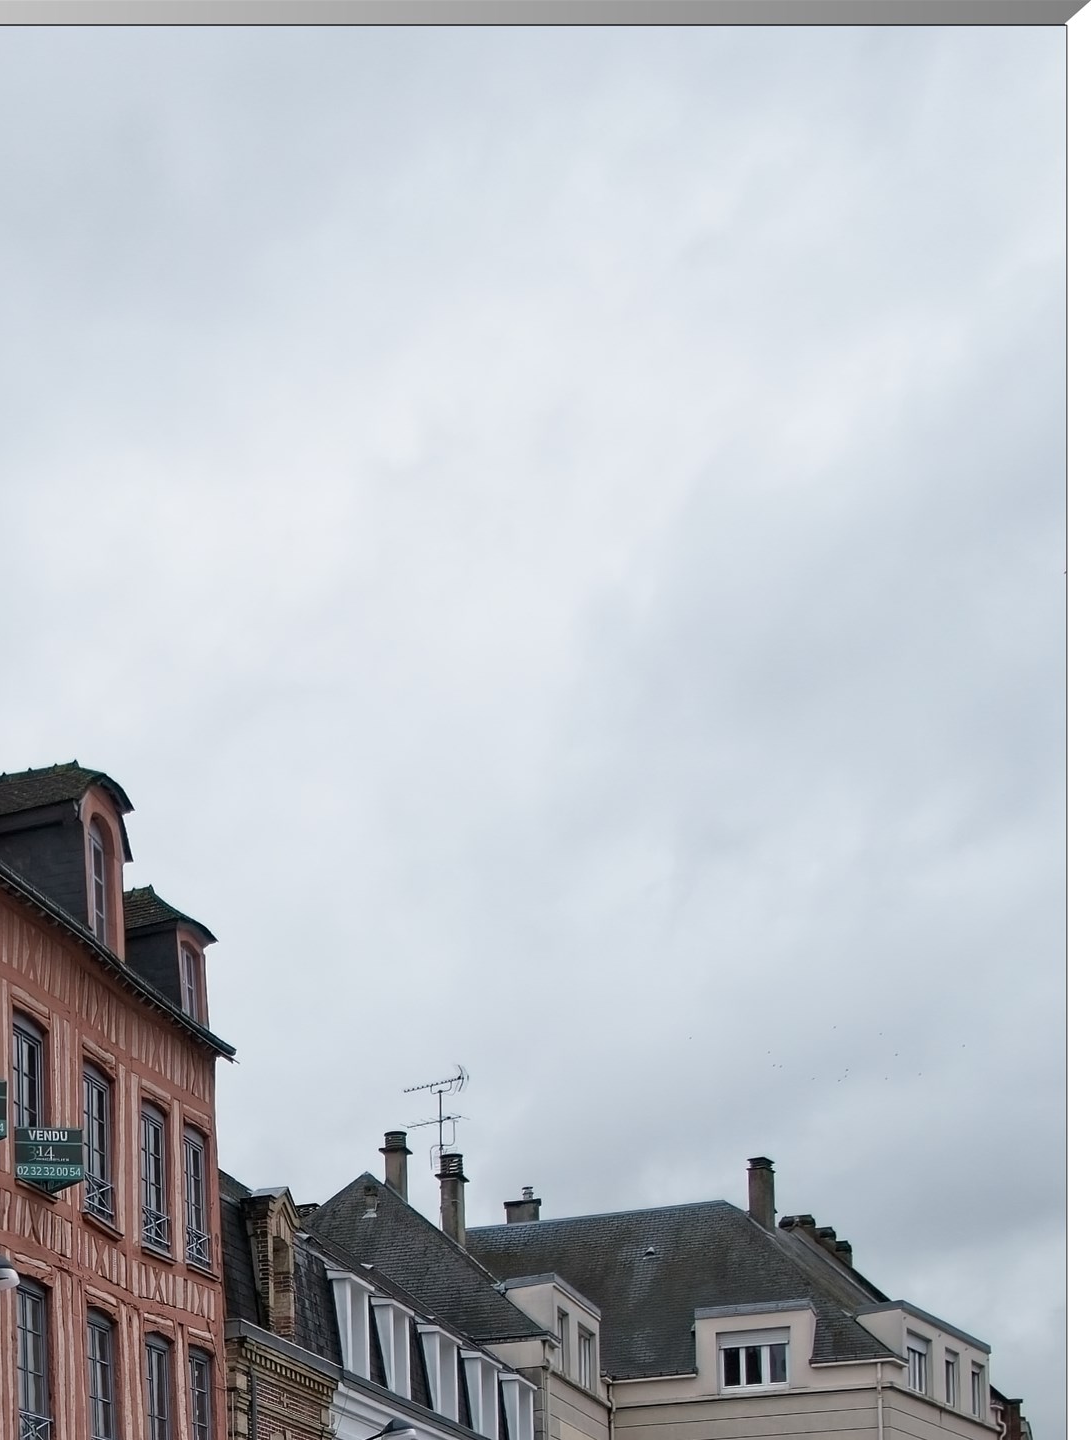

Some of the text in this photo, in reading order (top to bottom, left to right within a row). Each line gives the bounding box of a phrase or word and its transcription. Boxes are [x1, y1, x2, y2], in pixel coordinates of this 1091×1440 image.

[28, 1130, 68, 1142] VENDU
[17, 1165, 81, 1177] 02 32 32 00 54
